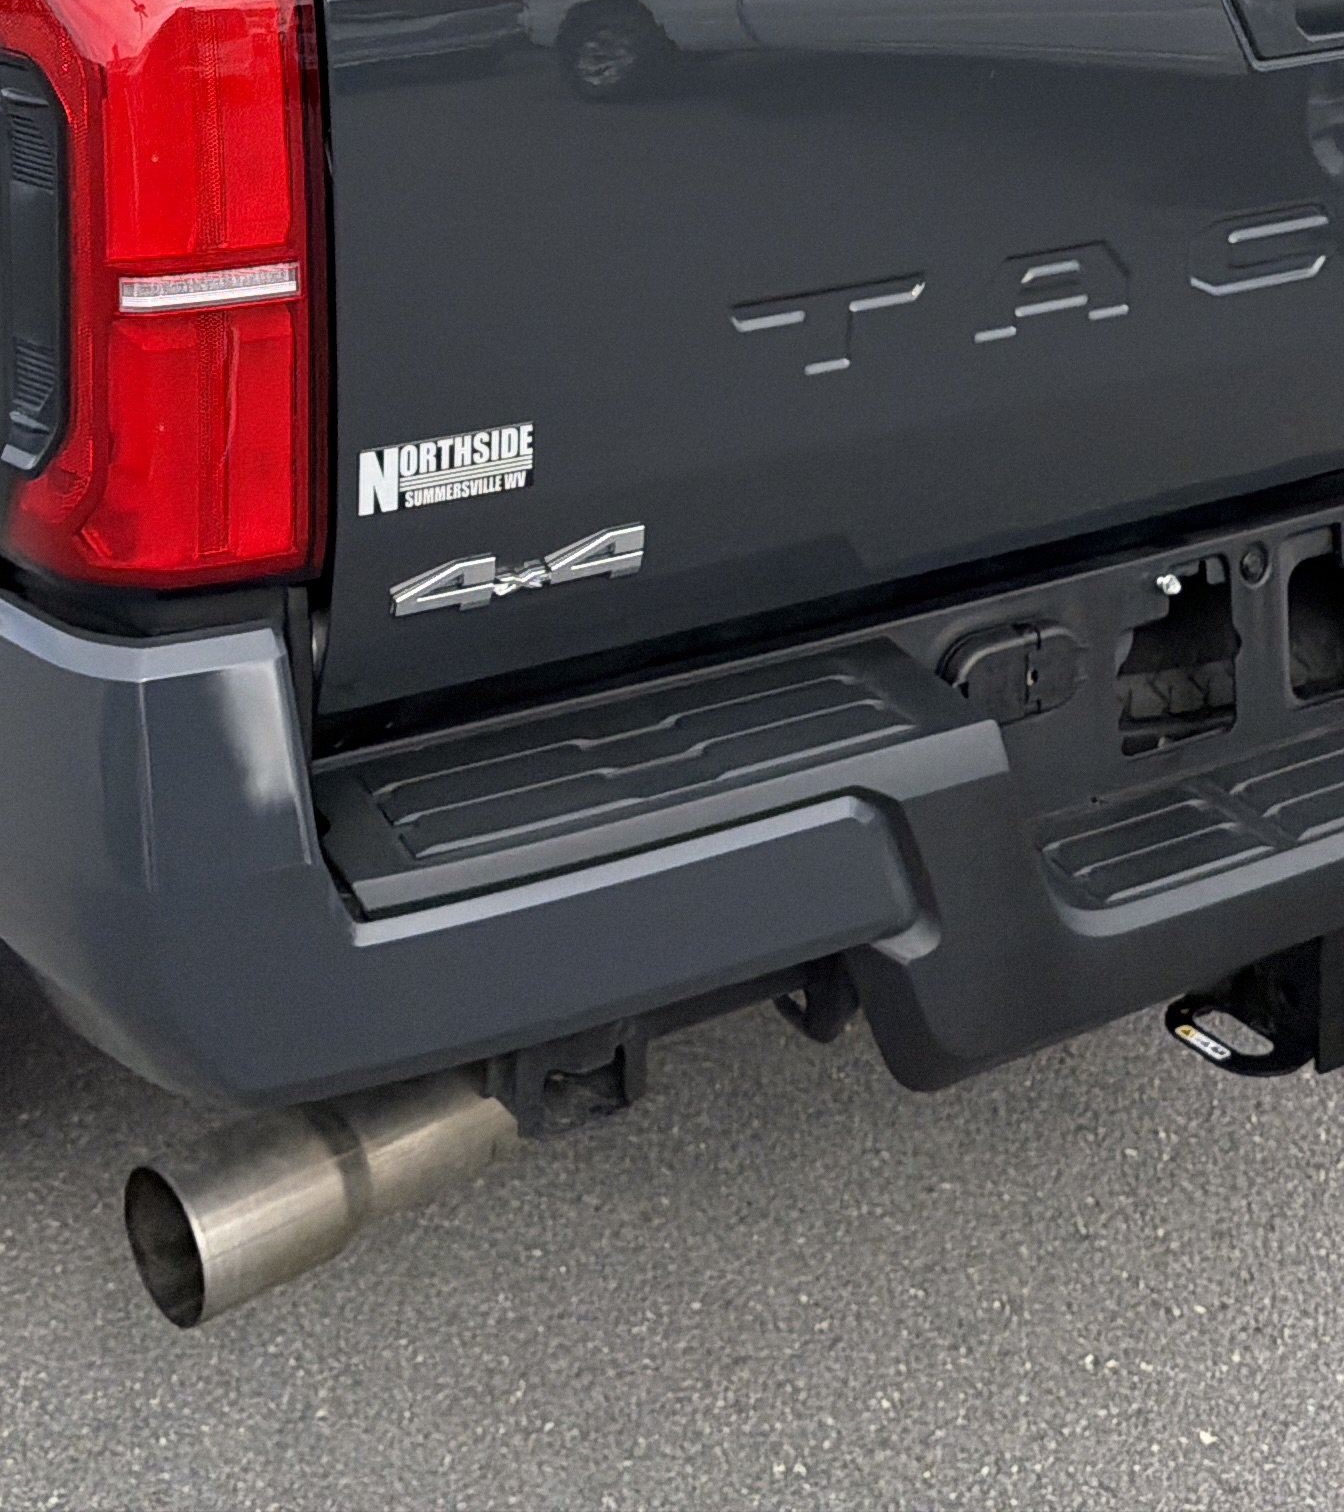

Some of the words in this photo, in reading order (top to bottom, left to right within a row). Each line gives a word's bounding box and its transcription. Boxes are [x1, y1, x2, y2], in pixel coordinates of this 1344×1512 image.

[357, 422, 535, 517] NORTHSIDE
[404, 474, 503, 508] SUMMERSVILLE
[503, 470, 527, 490] WV
